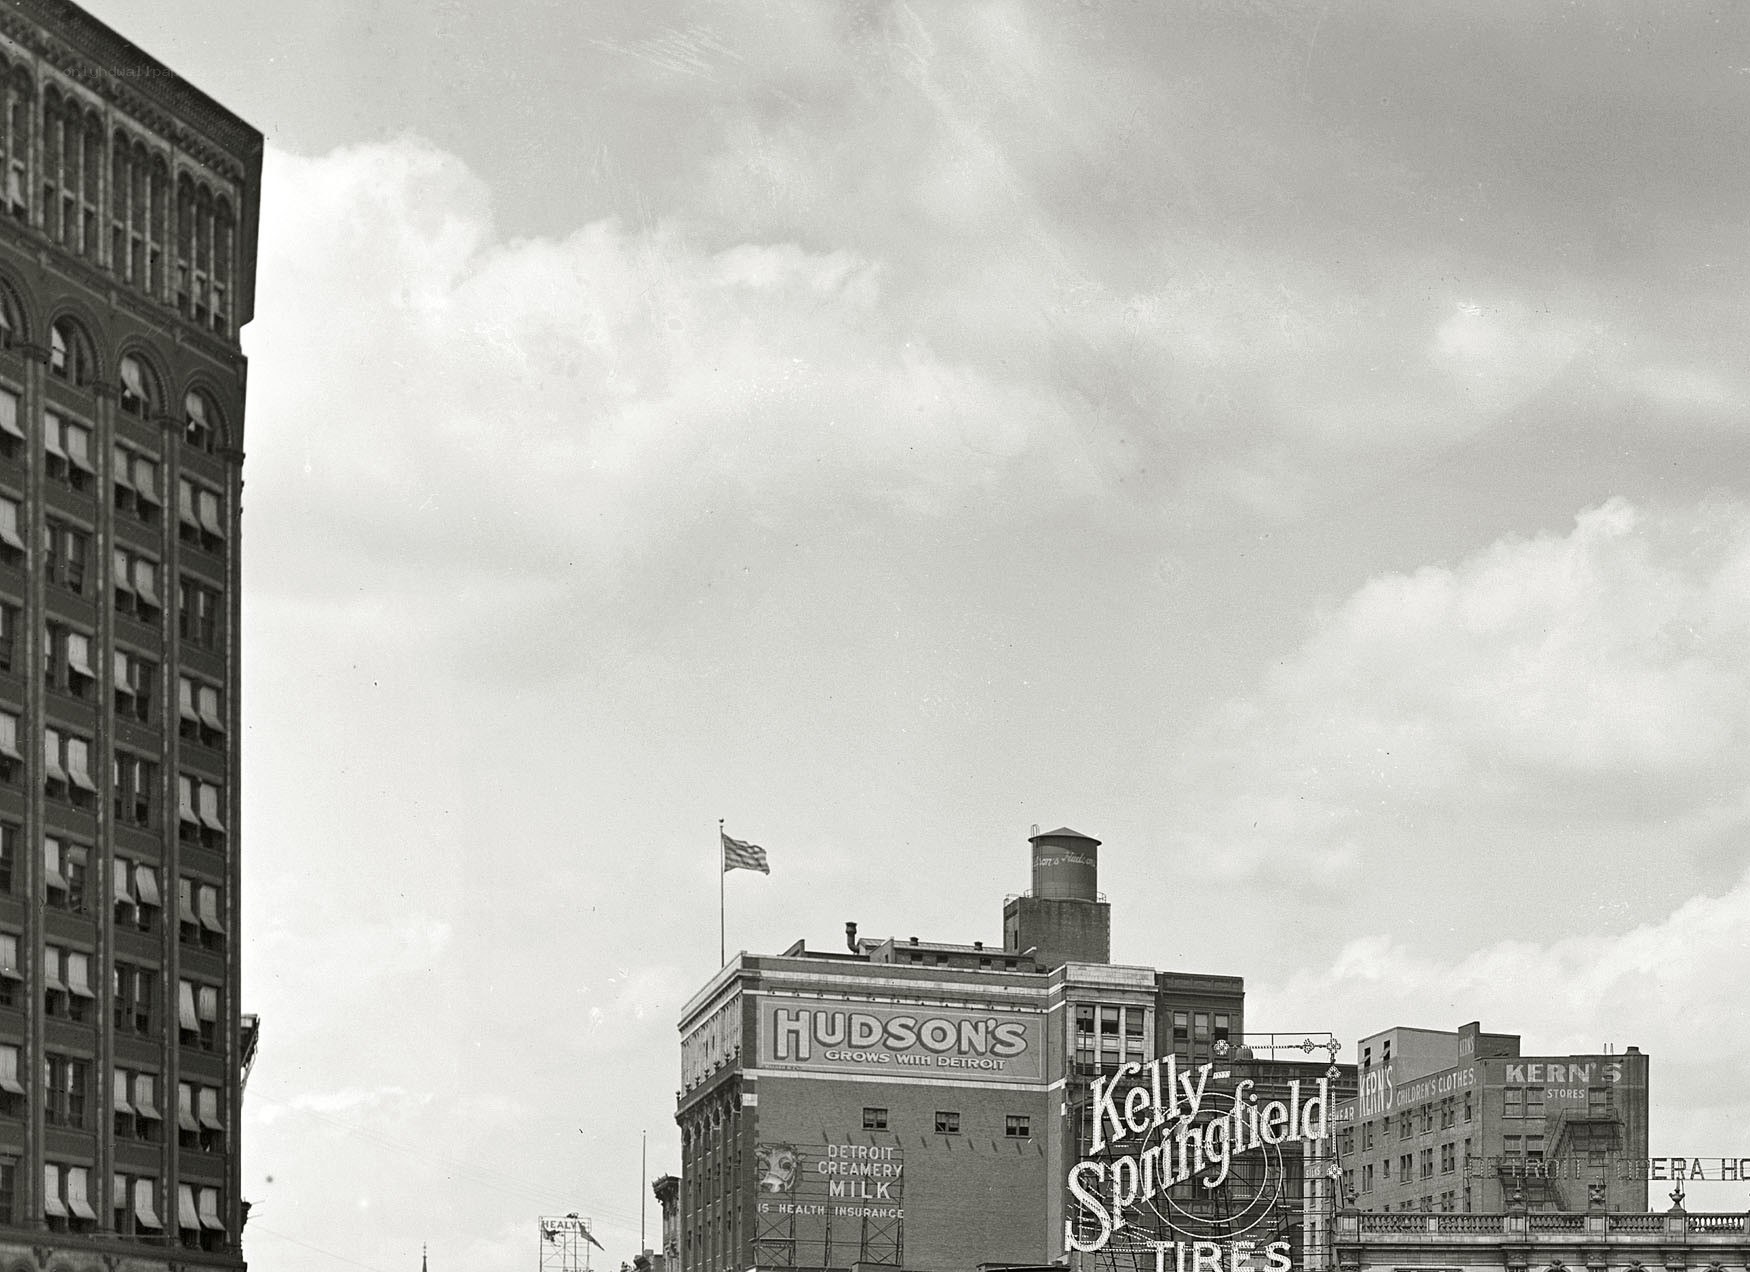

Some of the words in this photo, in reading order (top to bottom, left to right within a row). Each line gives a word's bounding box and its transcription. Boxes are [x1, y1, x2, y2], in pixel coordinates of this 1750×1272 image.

[774, 1008, 1028, 1061] HUDSON'S
[825, 1050, 890, 1063] GROWS
[896, 1055, 931, 1067] WITH
[937, 1056, 1006, 1071] DETROIT
[1505, 1063, 1623, 1083] KERN'S
[1358, 1064, 1393, 1118] KERN'S
[1396, 1078, 1437, 1106] CHILDREN'S
[1547, 1088, 1585, 1099] STORES
[1088, 1053, 1231, 1157] Kelly-
[828, 1144, 893, 1160] DETROIT
[818, 1161, 903, 1178] CREAMERY
[1064, 1077, 1330, 1252] Springfield
[1617, 1157, 1704, 1180] OPERA
[829, 1180, 891, 1199] MILK
[757, 1203, 770, 1214] IS
[779, 1203, 825, 1215] HEALTH
[834, 1205, 905, 1219] INSURANCE
